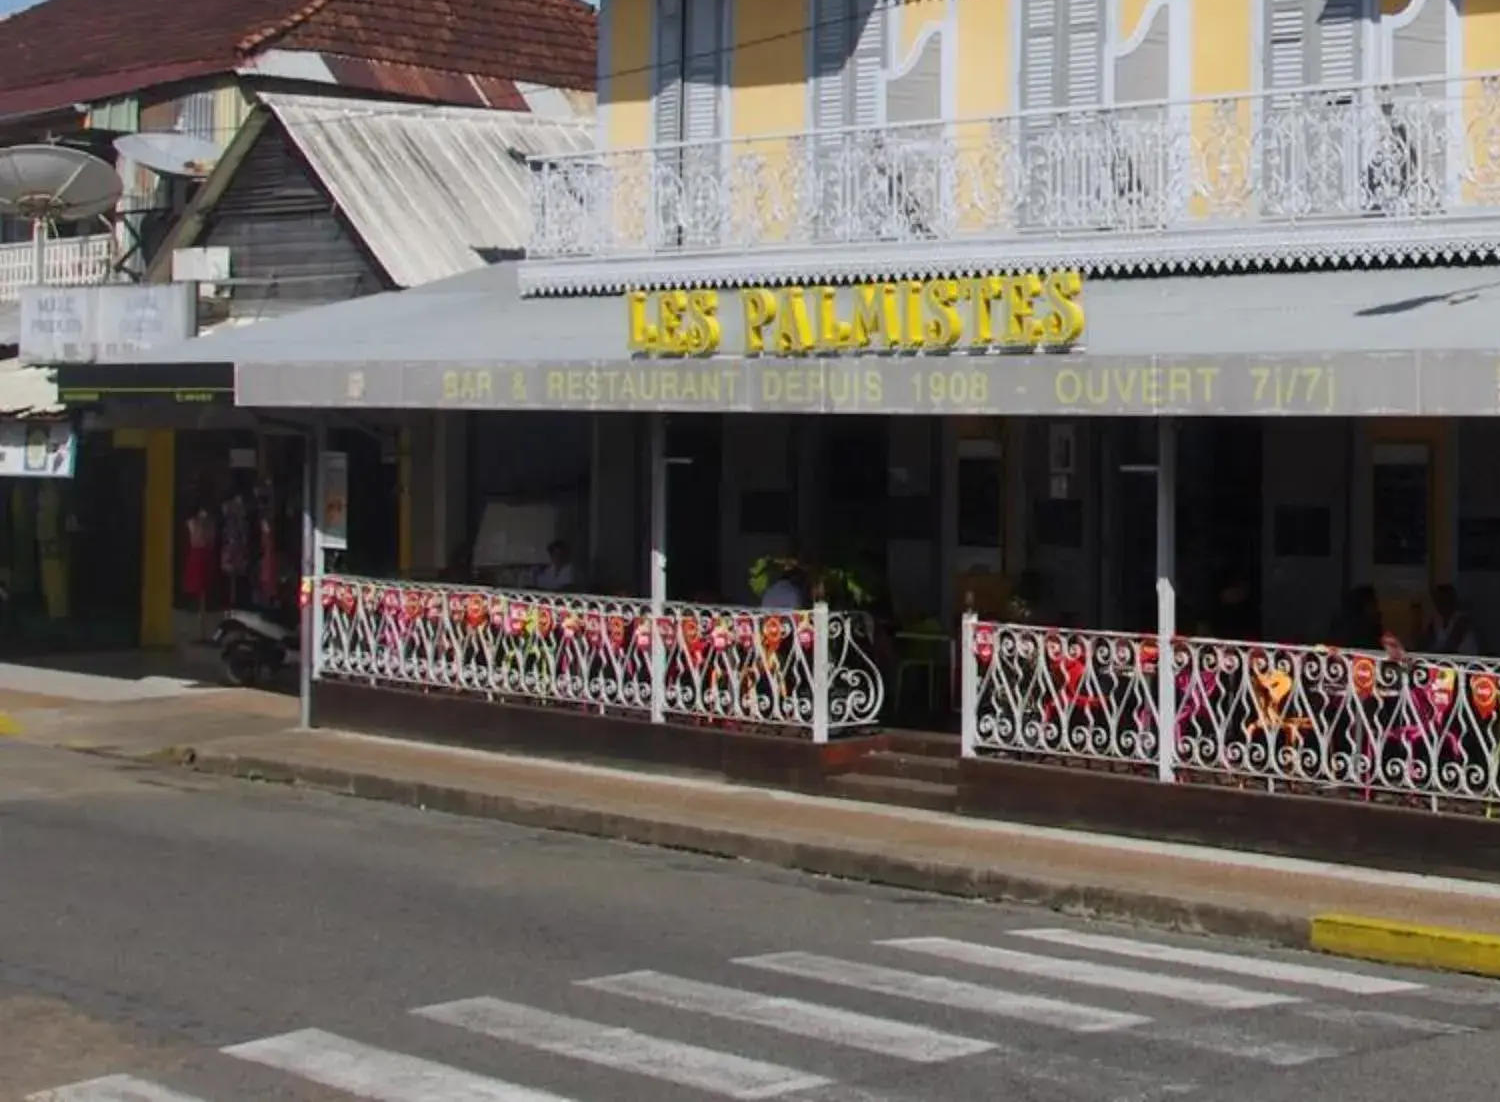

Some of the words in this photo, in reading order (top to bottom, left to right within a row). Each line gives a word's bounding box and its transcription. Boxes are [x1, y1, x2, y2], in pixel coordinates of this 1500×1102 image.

[627, 289, 720, 354] LES
[742, 271, 1086, 354] PALMISTES
[442, 370, 493, 400] BAR
[510, 370, 528, 401] &
[547, 370, 738, 402] RESTAURANT
[761, 369, 884, 402] DEPUIS
[910, 369, 989, 403] 1908
[1054, 367, 1221, 405] OUVERT
[1250, 365, 1336, 408] 7j/7j
